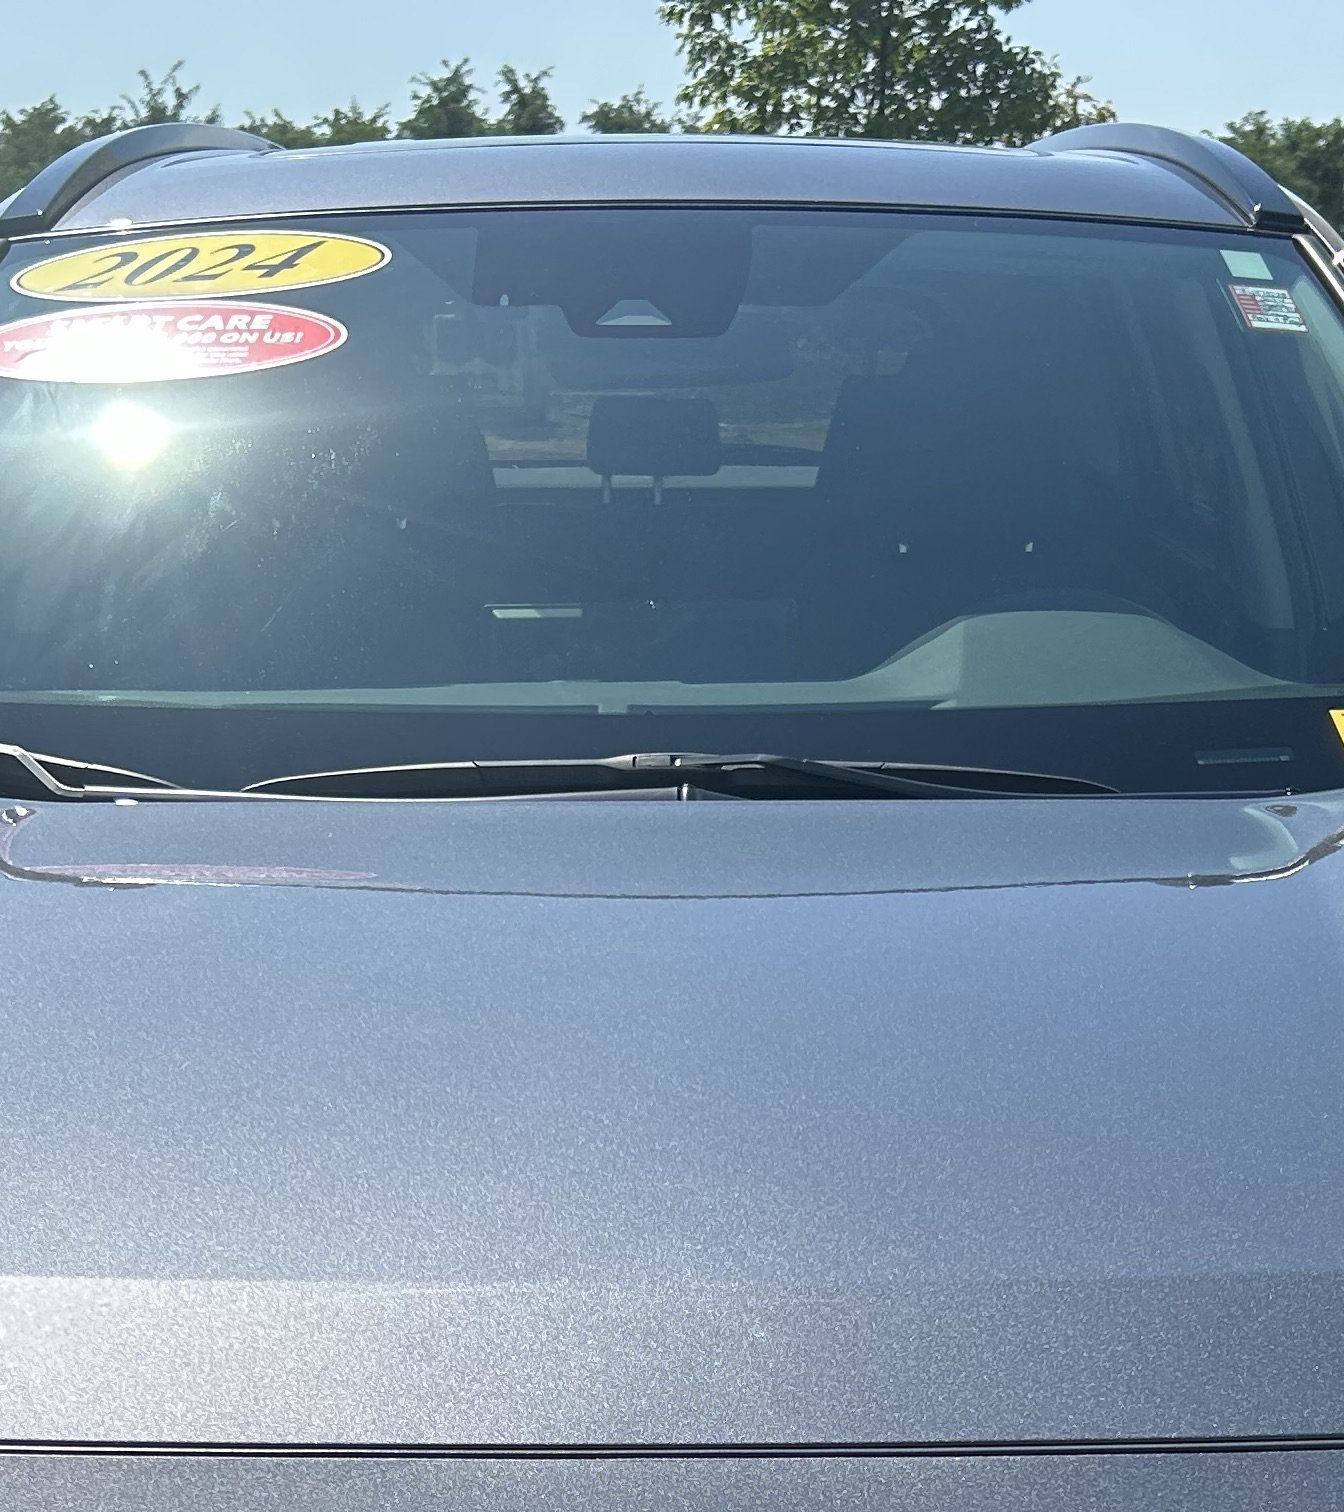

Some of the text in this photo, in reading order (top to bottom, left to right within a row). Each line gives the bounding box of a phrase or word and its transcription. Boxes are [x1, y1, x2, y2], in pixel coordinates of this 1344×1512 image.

[53, 238, 327, 293] 2024
[177, 313, 274, 333] CARE
[219, 331, 259, 344] ON
[262, 330, 305, 344] US!
